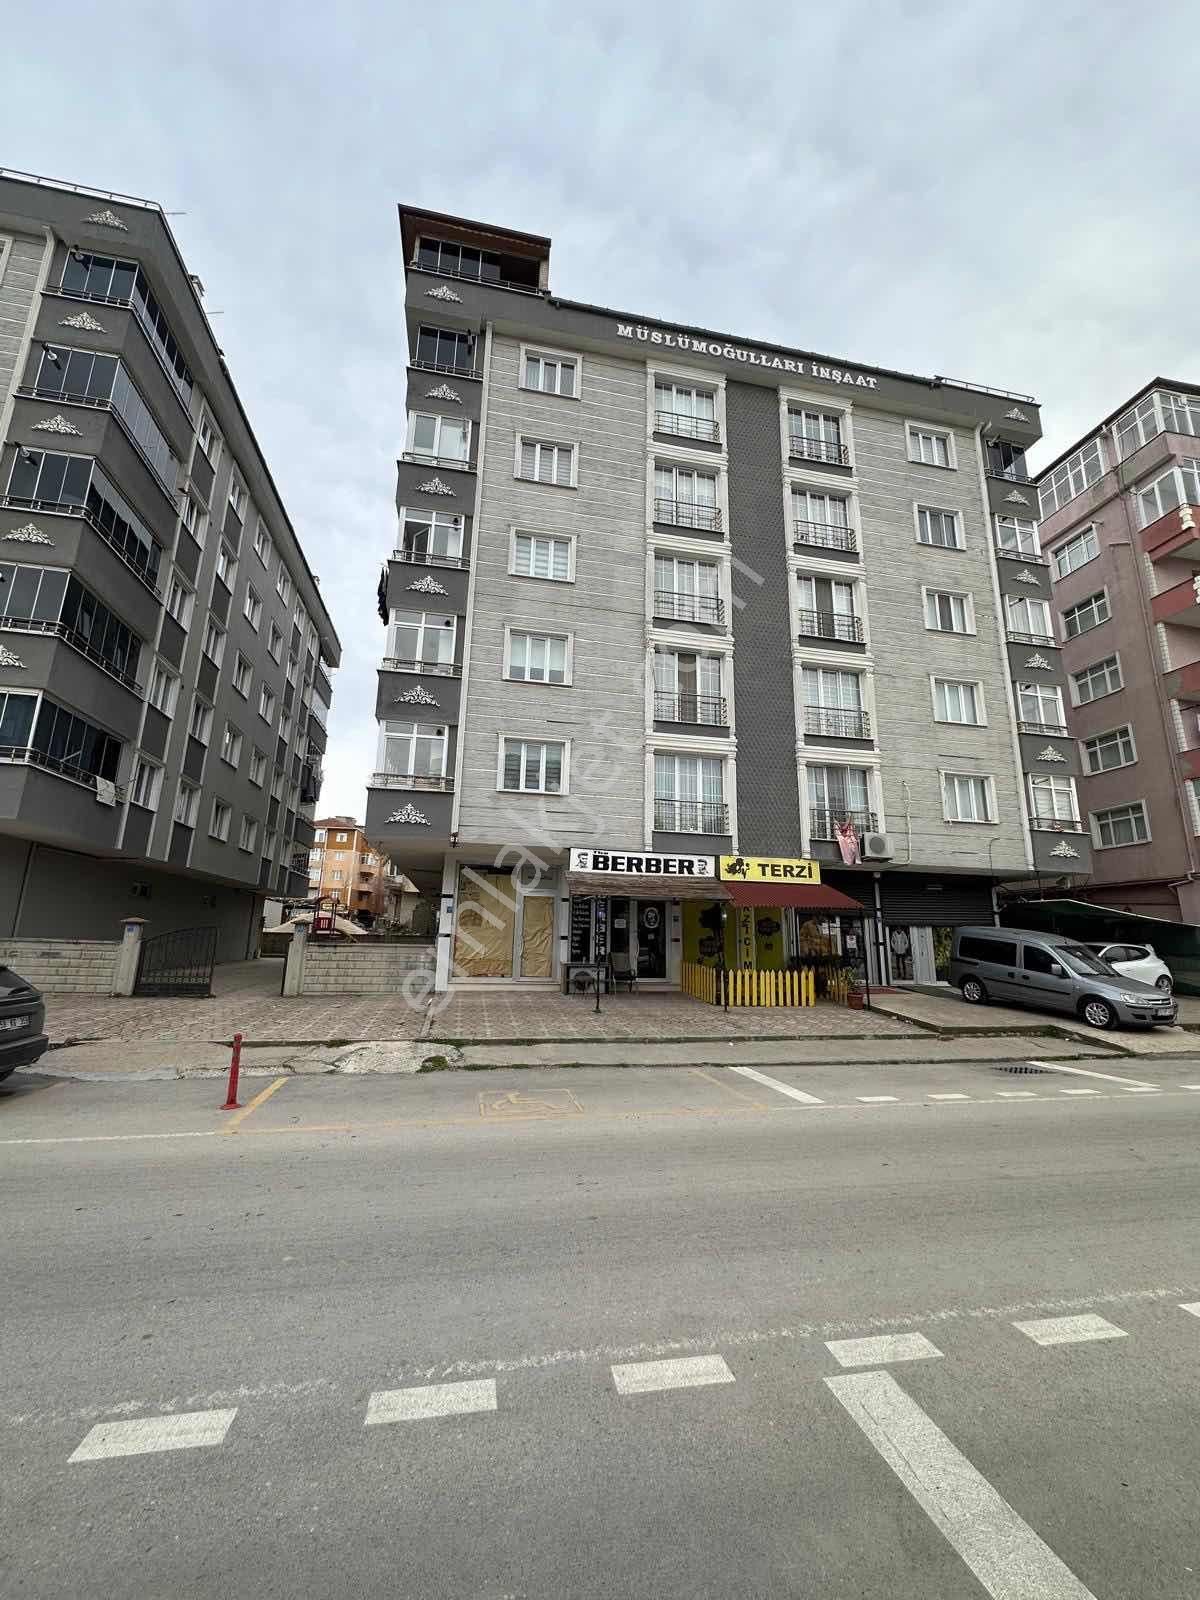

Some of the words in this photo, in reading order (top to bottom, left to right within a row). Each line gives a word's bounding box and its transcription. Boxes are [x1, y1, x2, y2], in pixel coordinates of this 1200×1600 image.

[616, 323, 804, 374] MÜSLÜMOĞULLARI
[811, 361, 878, 389] İNŞAAT
[592, 854, 695, 875] BERBER
[757, 862, 813, 879] TERZİ
